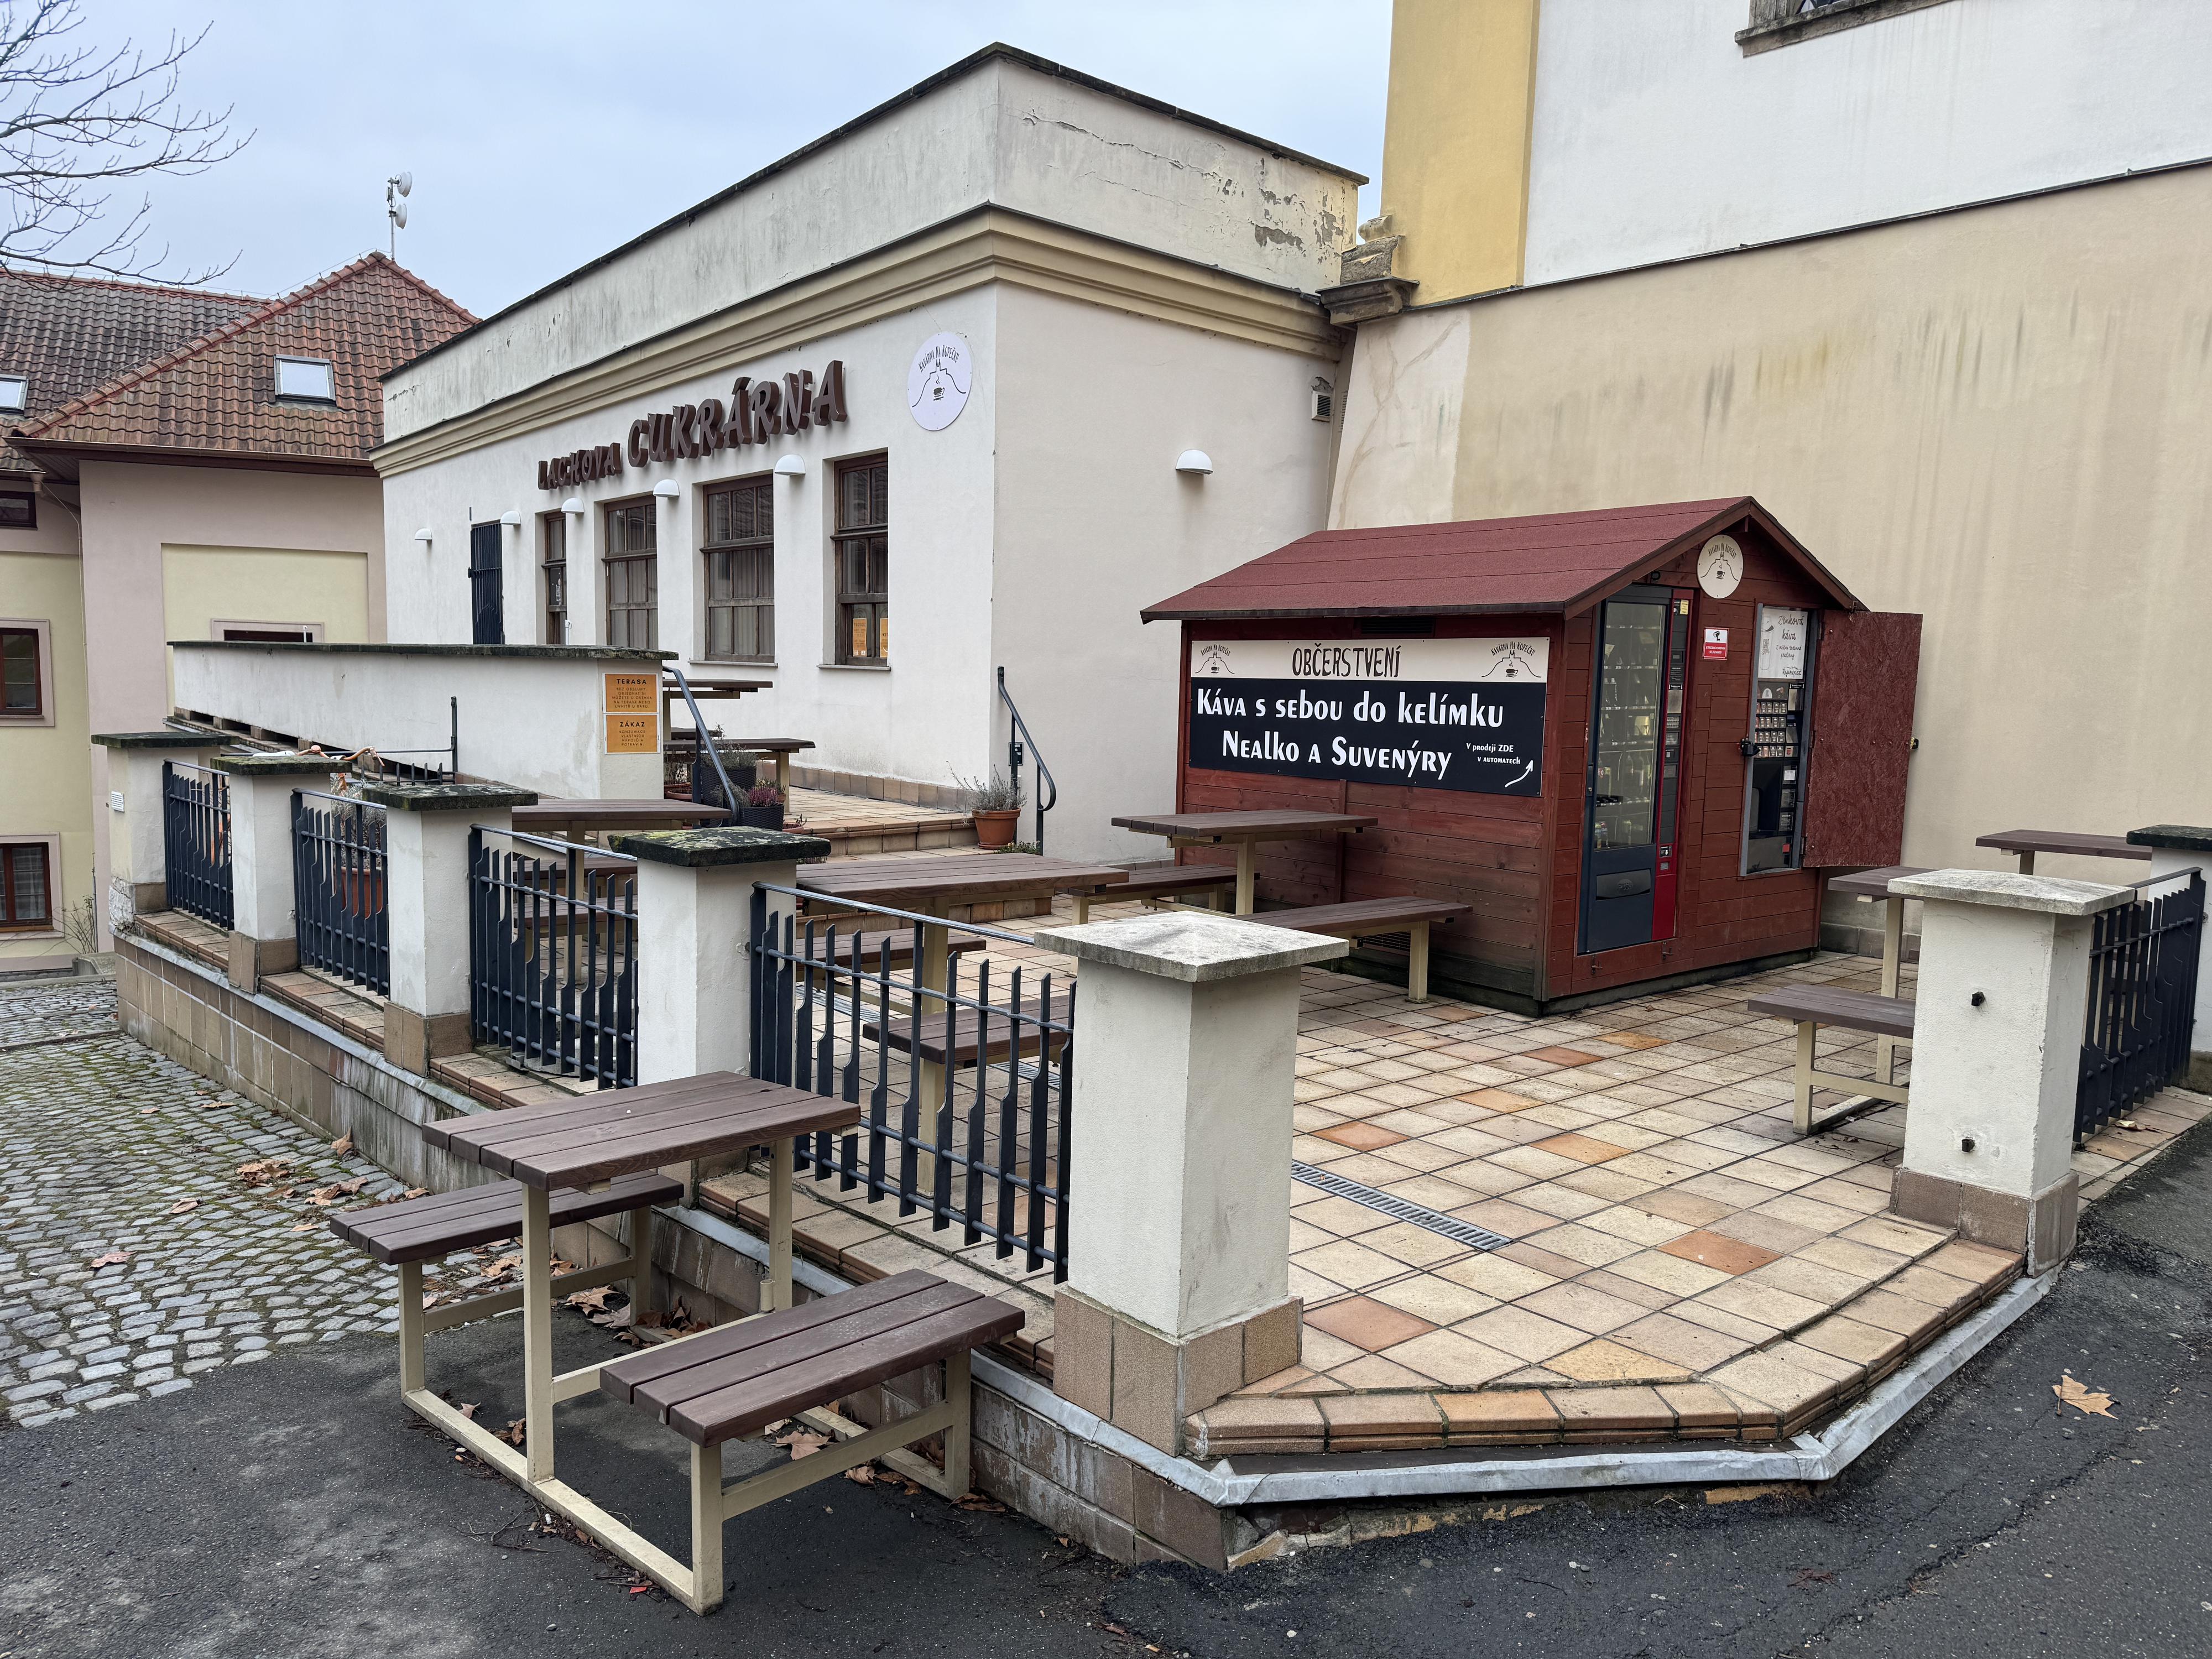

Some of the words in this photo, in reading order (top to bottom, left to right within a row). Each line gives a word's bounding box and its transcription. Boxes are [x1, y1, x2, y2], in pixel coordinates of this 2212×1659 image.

[936, 346, 941, 358] NA
[538, 442, 623, 490] LACHOVA
[627, 359, 848, 468] CUKRÁRNA
[1510, 641, 1515, 649] NA
[1292, 642, 1402, 677] OBČERSTVENÍ
[1255, 698, 1266, 717] s
[1275, 689, 1343, 721] sebou
[1353, 691, 1386, 722] do
[1398, 691, 1504, 727] kelímku
[1472, 743, 1496, 753] prodeji
[1498, 744, 1514, 752] ZDE
